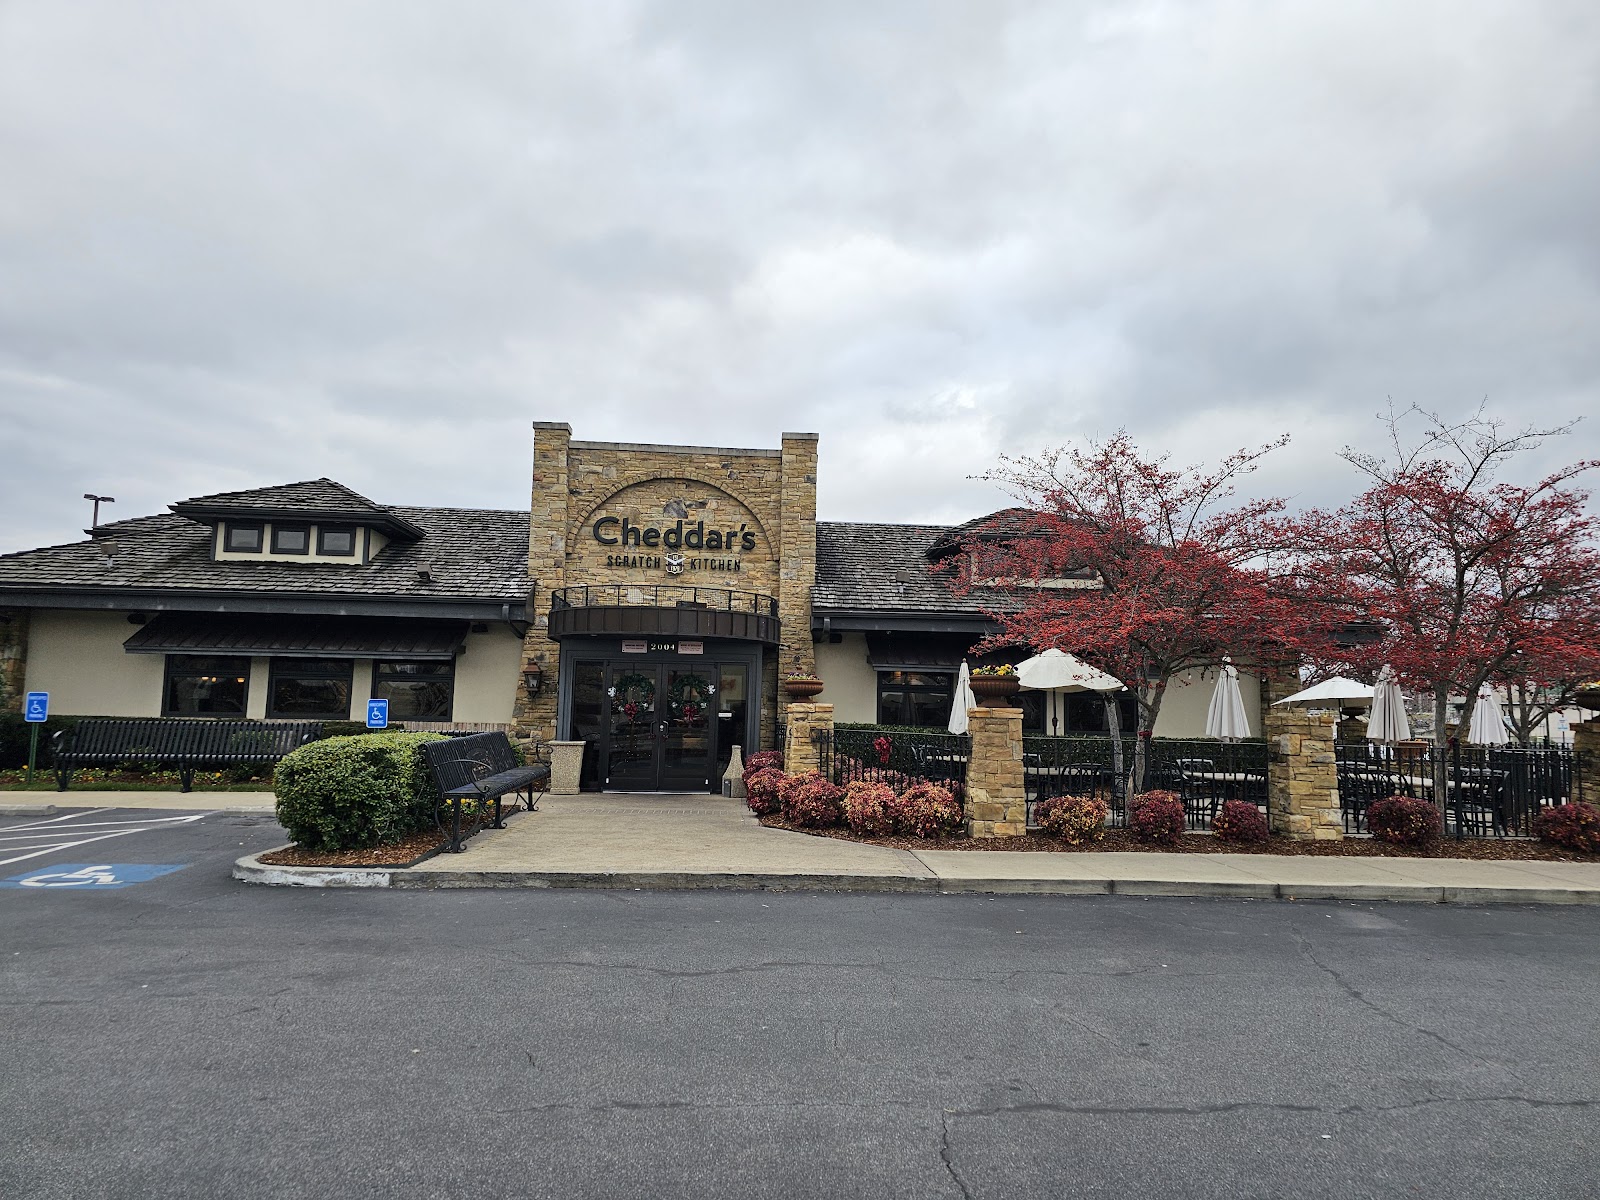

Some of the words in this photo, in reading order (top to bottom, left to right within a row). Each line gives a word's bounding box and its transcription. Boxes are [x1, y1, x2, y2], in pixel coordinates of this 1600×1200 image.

[593, 516, 756, 550] Cheddar's
[607, 555, 661, 569] SCRATCH
[690, 558, 741, 571] KITCHEN
[650, 643, 675, 651] 2004
